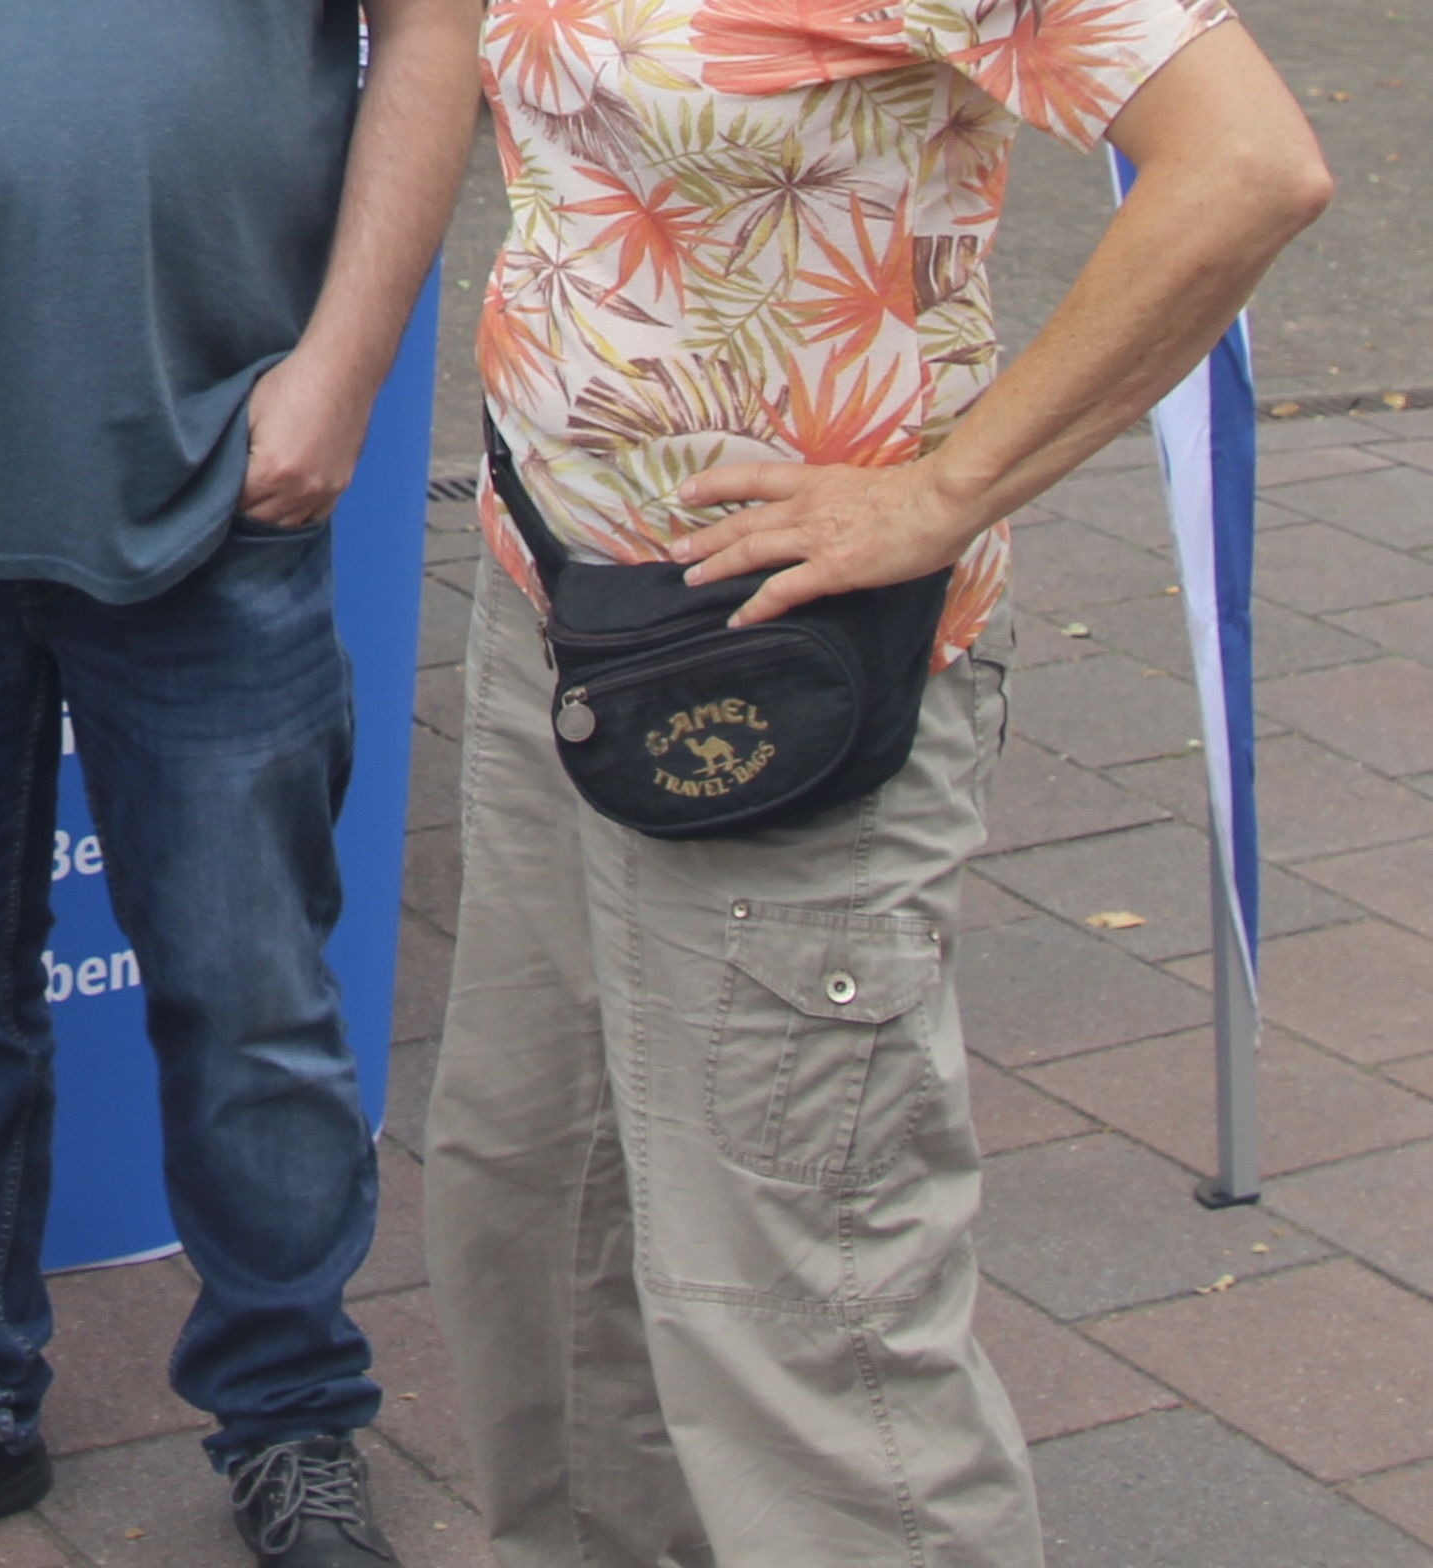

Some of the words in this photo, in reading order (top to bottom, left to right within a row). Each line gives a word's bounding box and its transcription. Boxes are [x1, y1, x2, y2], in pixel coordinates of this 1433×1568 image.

[645, 697, 769, 757] CAMEL
[51, 829, 105, 882] Be
[39, 948, 142, 1003] ben
